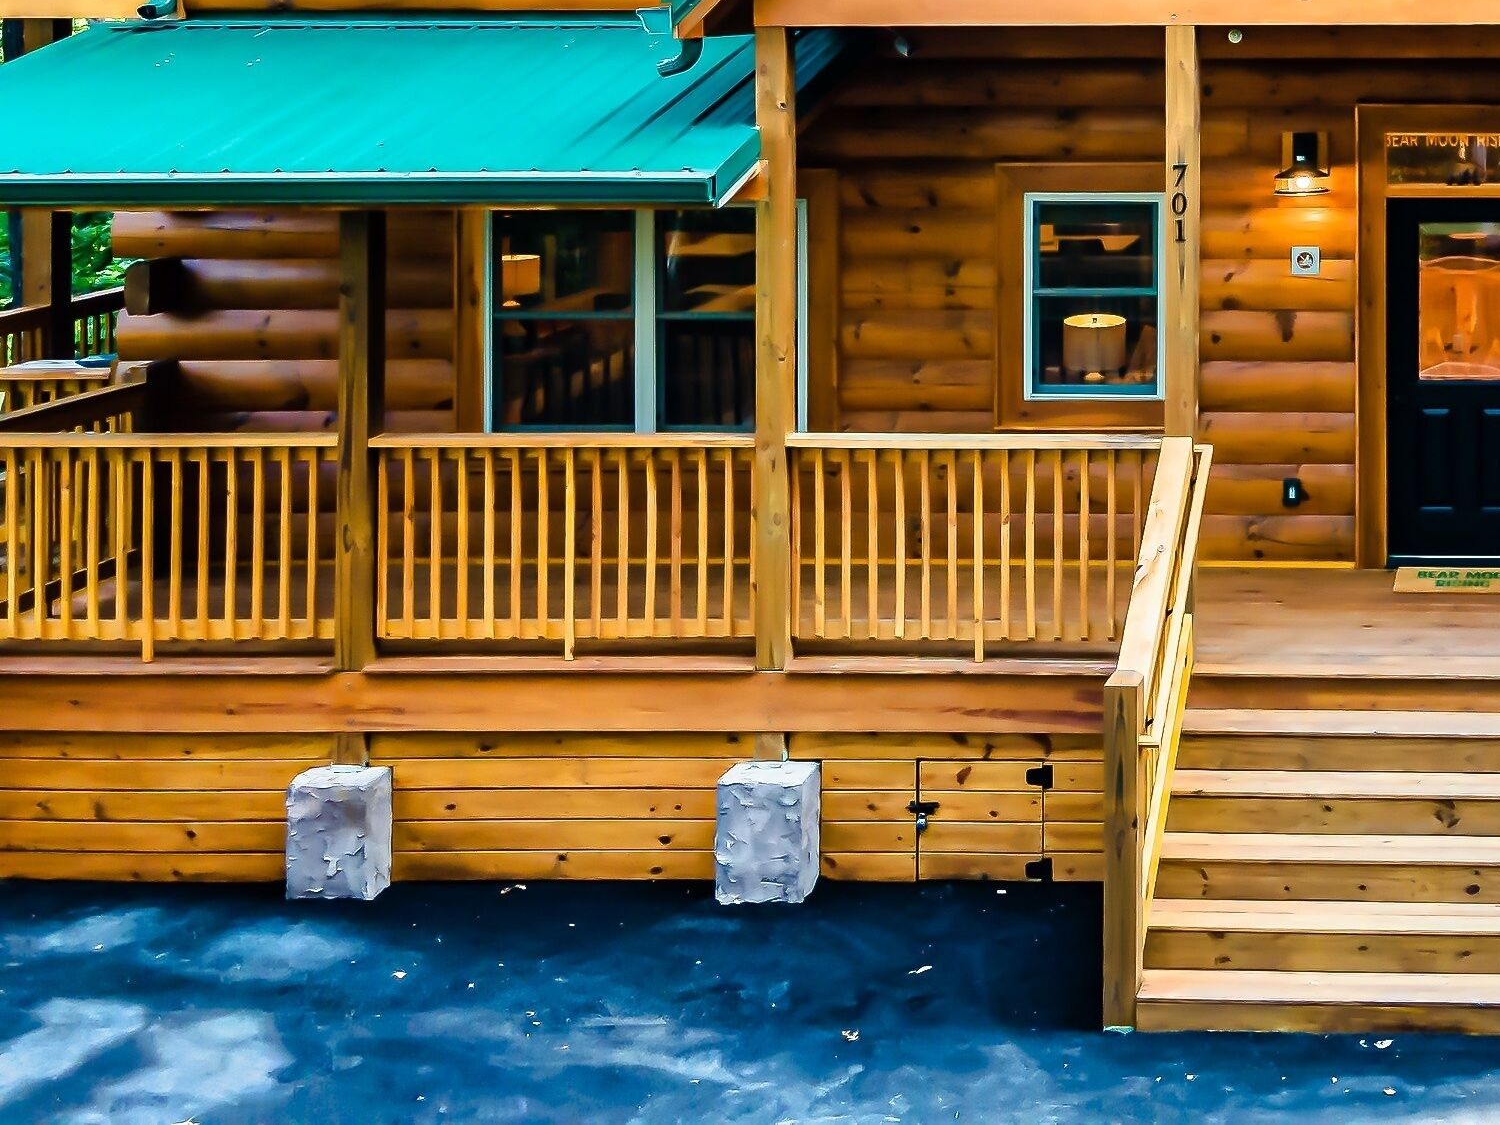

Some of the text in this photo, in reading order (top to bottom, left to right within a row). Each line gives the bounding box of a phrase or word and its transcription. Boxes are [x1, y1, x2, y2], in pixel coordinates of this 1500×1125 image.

[1425, 135, 1469, 147] MOON
[1171, 164, 1188, 243] 701
[1417, 570, 1459, 580] BEAR
